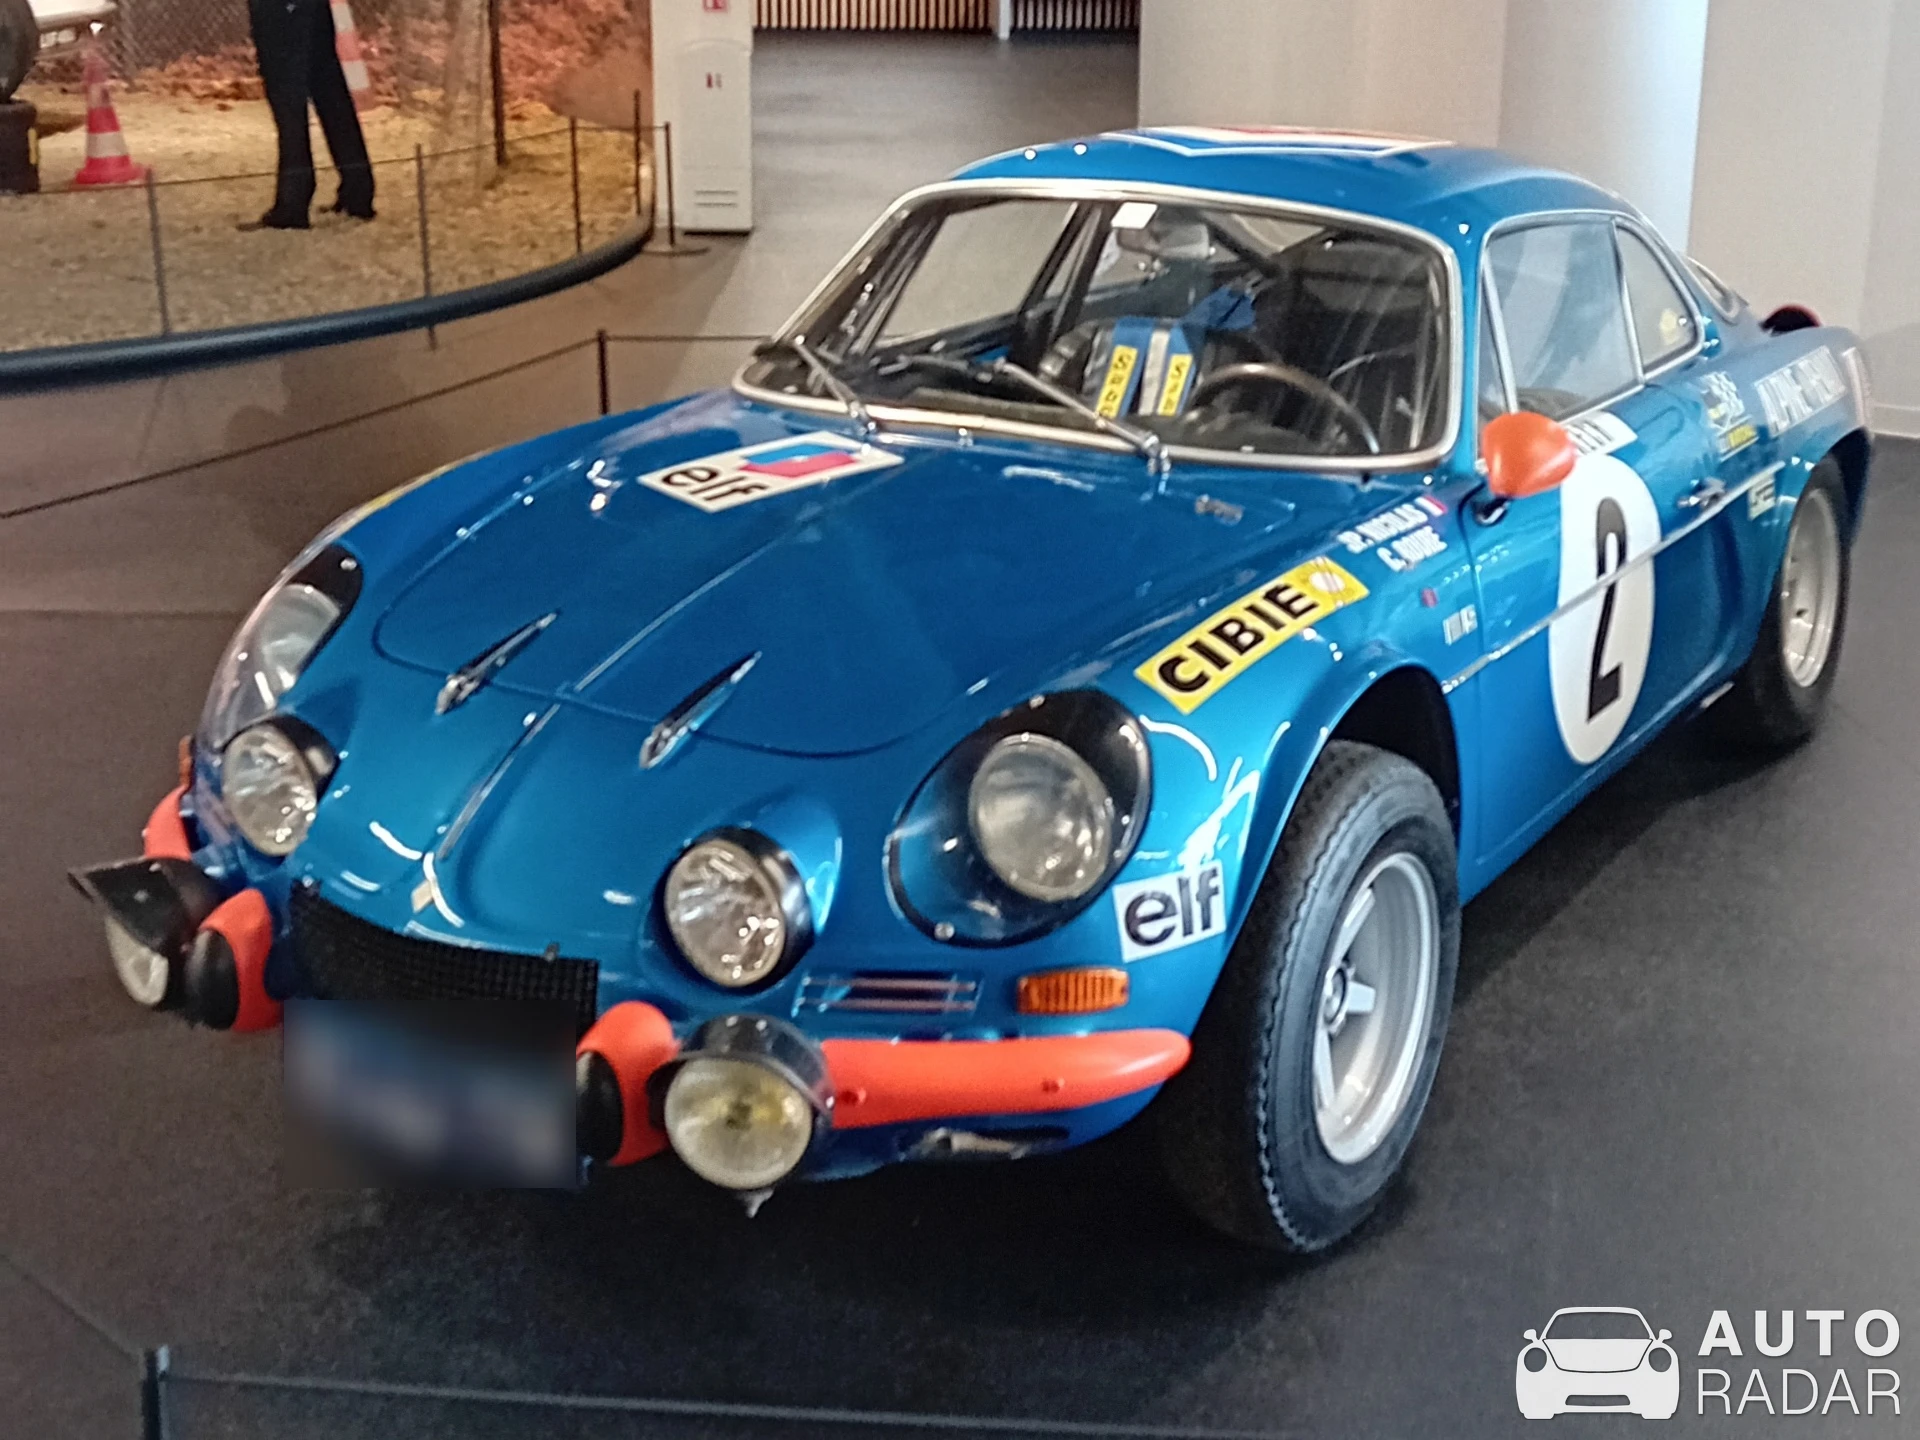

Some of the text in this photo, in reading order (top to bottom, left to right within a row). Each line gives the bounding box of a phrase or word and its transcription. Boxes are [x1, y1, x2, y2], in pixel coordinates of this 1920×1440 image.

[661, 467, 769, 501] elf
[1158, 583, 1320, 693] CIBIE
[1587, 497, 1627, 723] 2
[1124, 866, 1219, 947] elf
